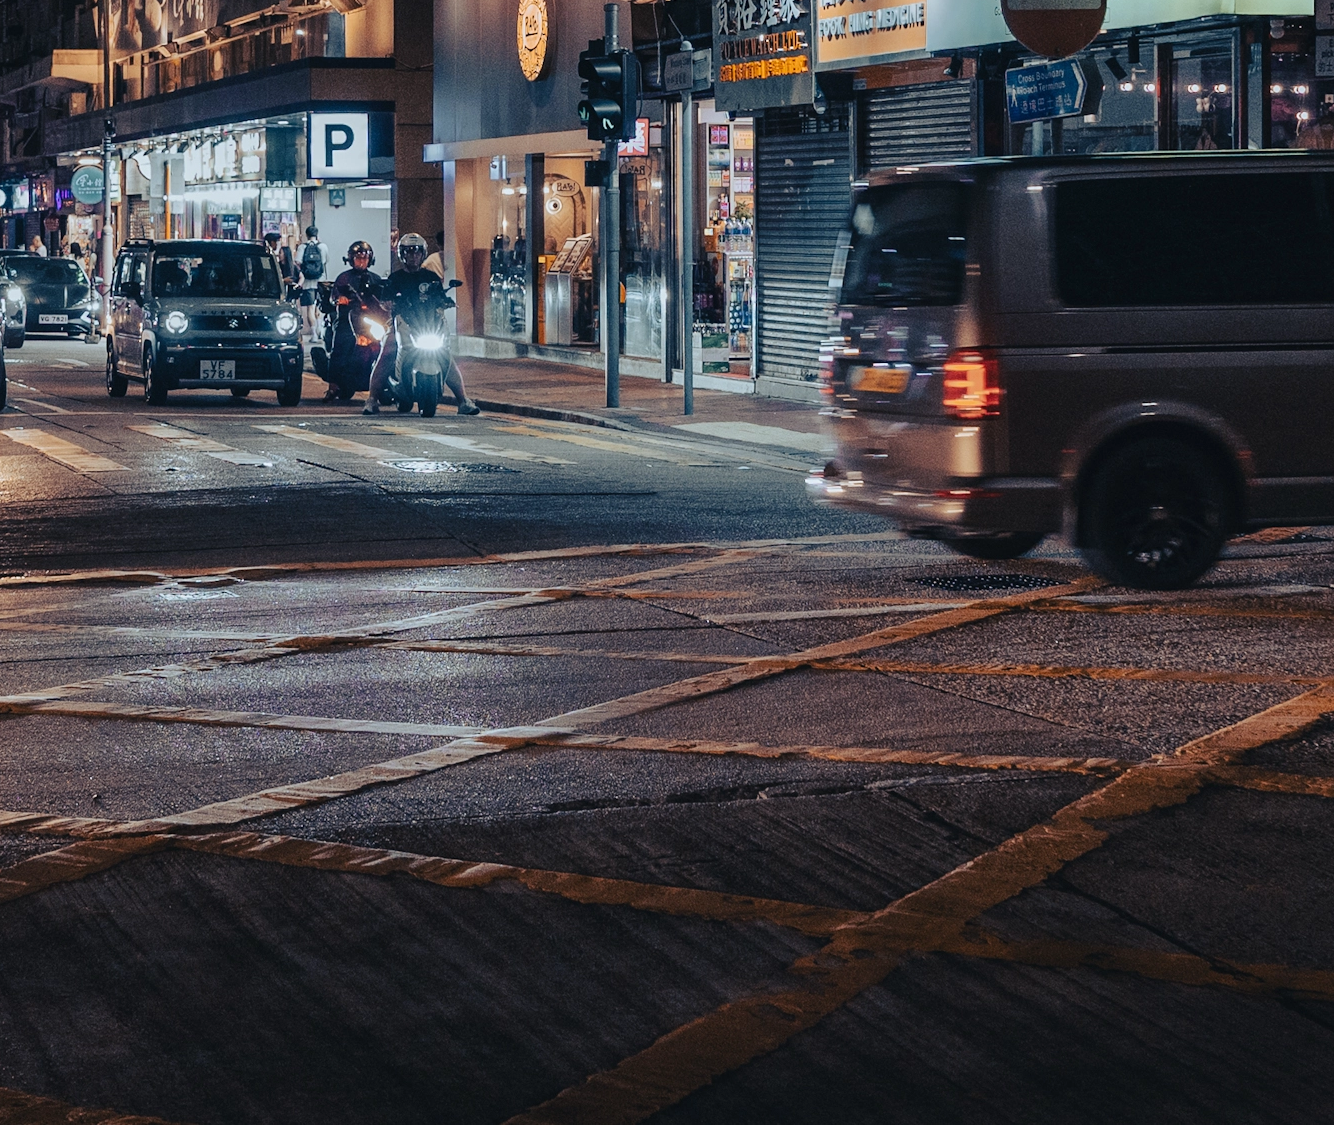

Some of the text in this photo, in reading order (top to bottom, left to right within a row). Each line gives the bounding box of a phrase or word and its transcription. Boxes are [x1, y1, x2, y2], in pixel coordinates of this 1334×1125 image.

[819, 2, 925, 38] FOOK HING MEDICINE
[750, 33, 779, 57] WATCH
[1017, 69, 1065, 84] Cross Boundary
[1038, 81, 1066, 93] Terminus
[325, 124, 354, 167] P
[210, 361, 225, 370] VF
[202, 369, 234, 379] 5784
